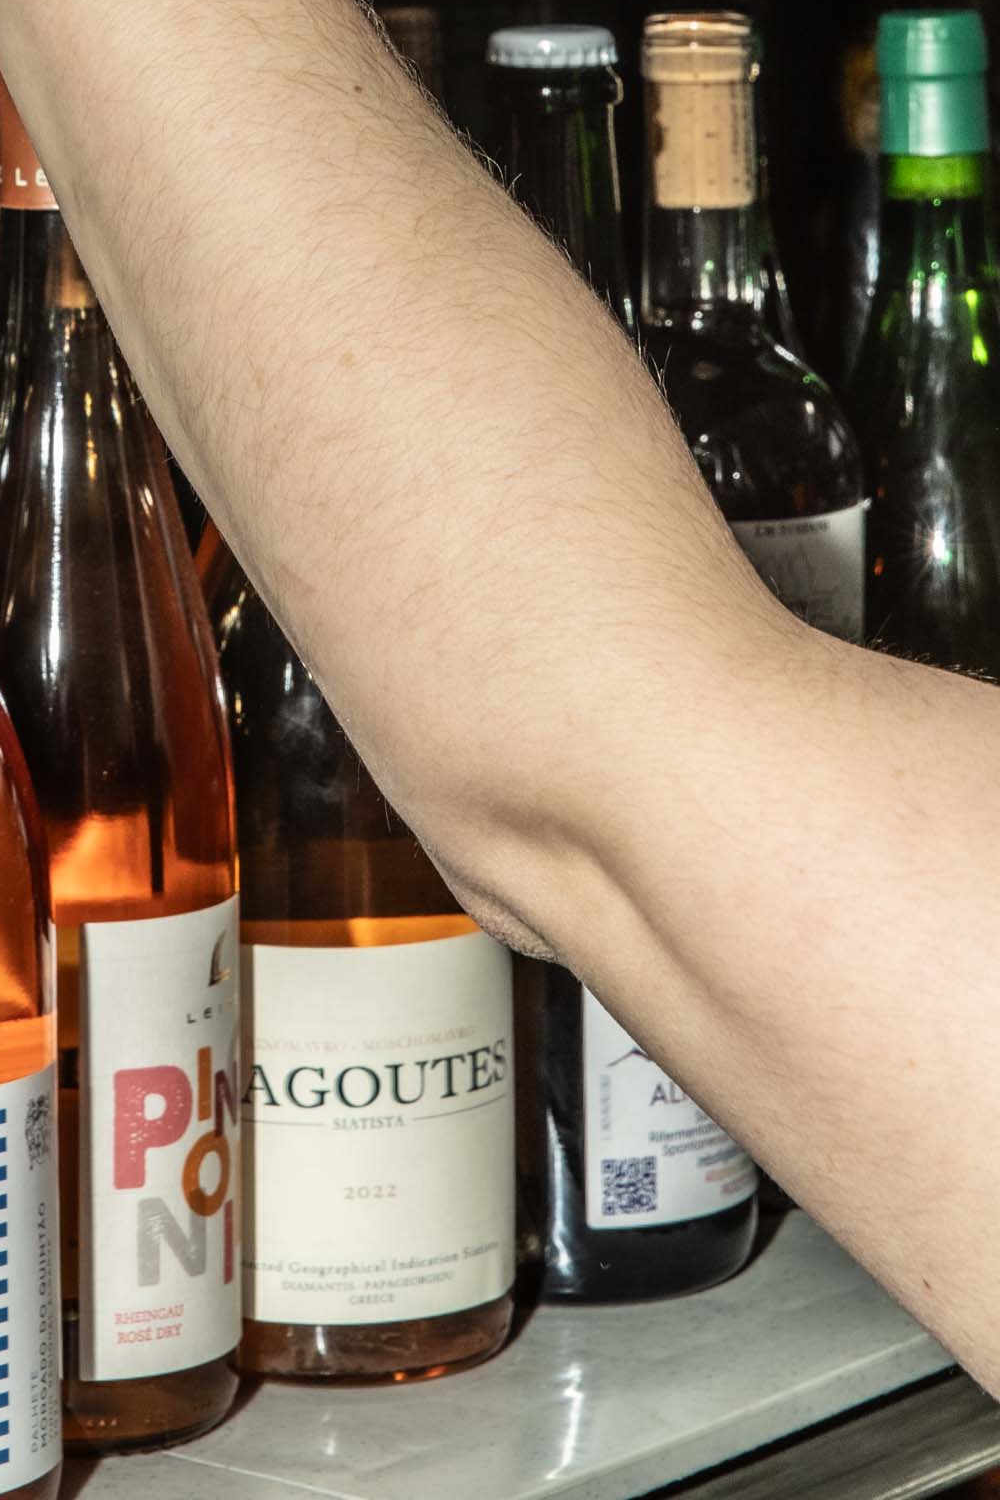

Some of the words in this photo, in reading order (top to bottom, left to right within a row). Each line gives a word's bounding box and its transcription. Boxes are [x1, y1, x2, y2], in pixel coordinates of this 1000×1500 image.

[240, 1038, 508, 1109] AGOUTES
[333, 1115, 405, 1131] SIATISTA
[344, 1184, 397, 1201] 2022
[36, 1201, 47, 1296] QUINTÃO
[288, 1259, 386, 1278] Geographical
[391, 1252, 459, 1271] Indication
[114, 1304, 185, 1326] RHEINGAU
[116, 1326, 153, 1346] ROSÉ
[155, 1323, 183, 1341] DRY
[38, 1341, 49, 1449] MORGADO
